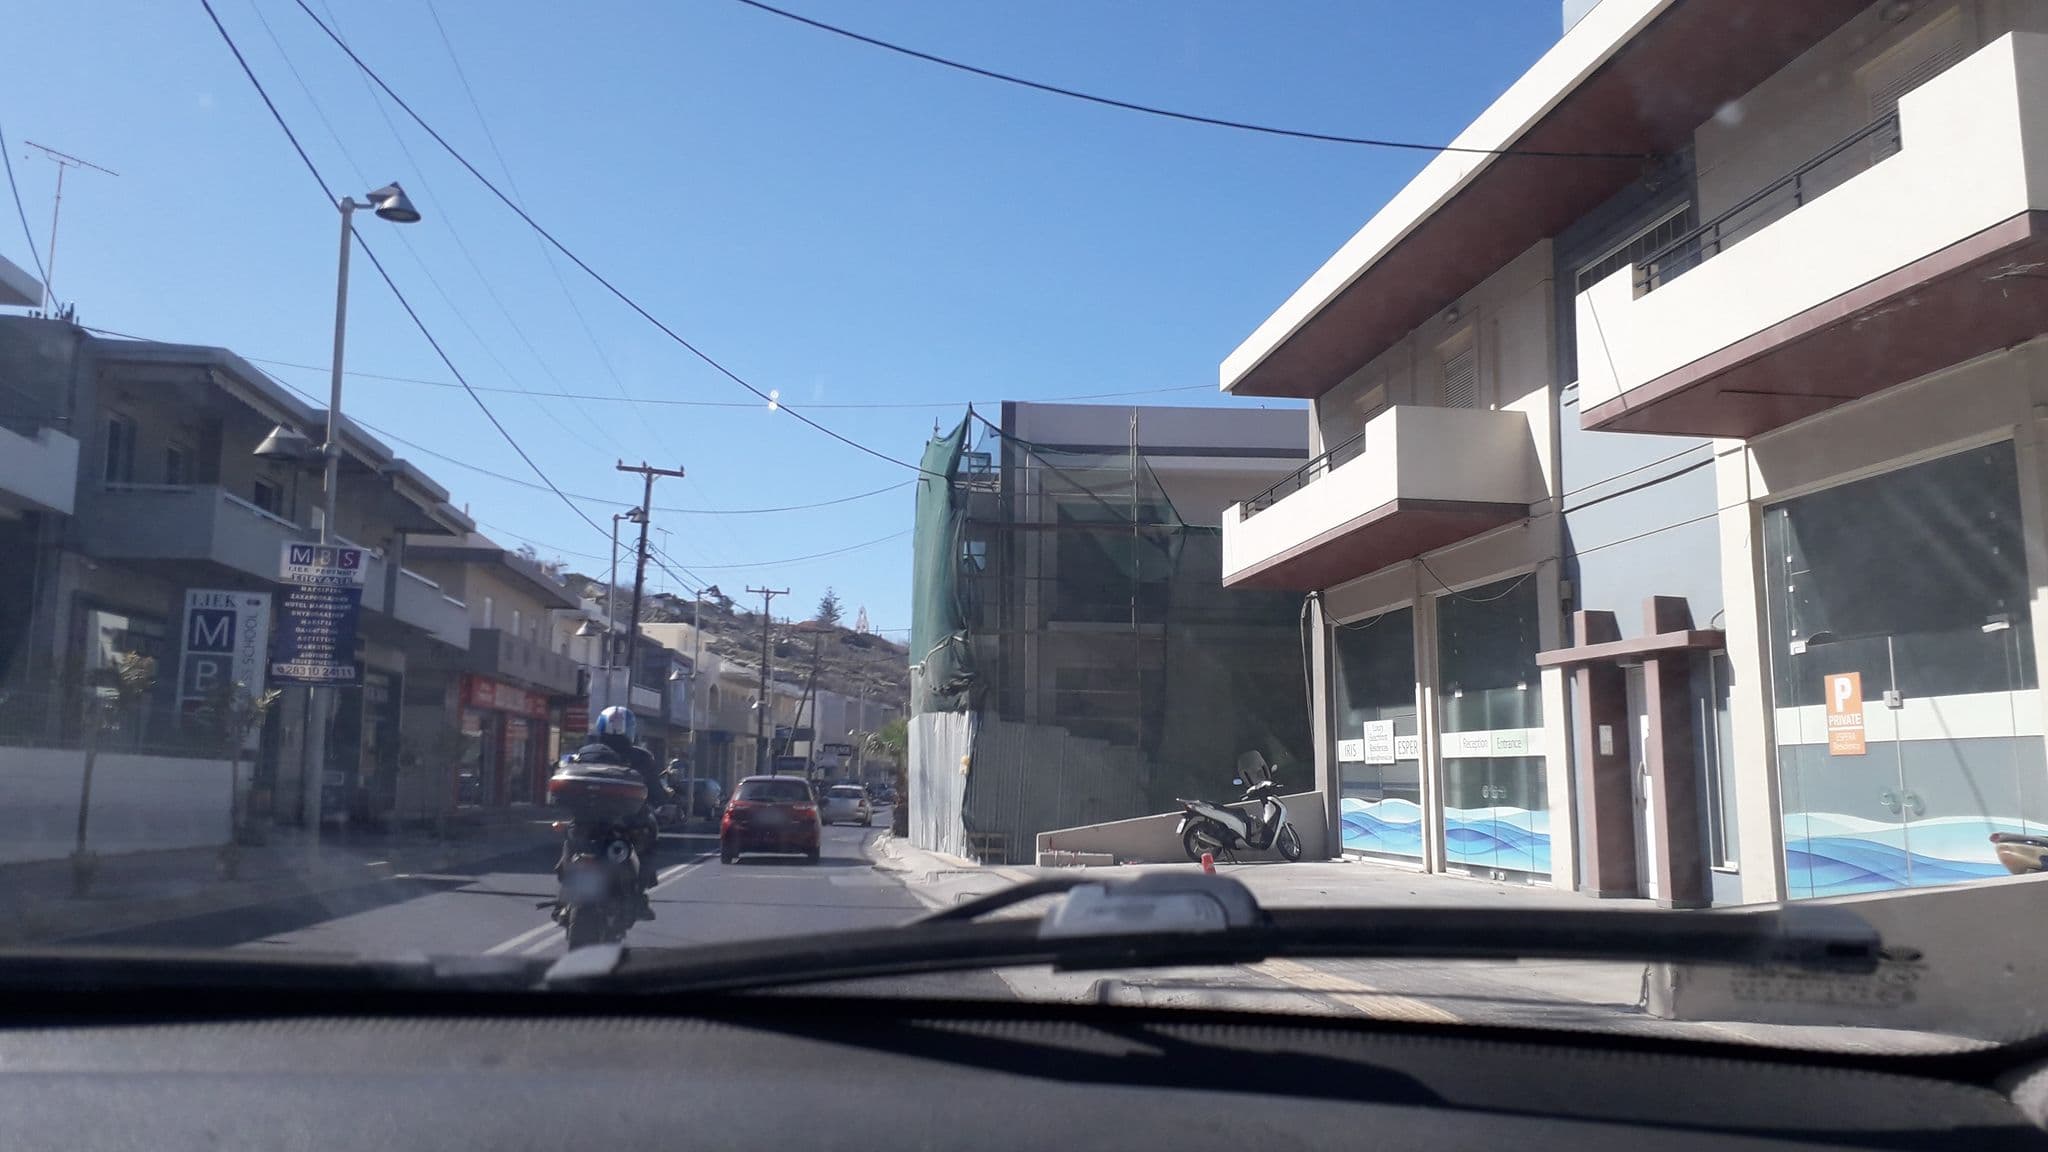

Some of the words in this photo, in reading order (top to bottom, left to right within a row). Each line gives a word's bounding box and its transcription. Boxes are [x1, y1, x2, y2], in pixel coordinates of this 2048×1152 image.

[194, 615, 228, 648] M
[241, 612, 258, 665] SCHOOL
[1833, 677, 1853, 713] P
[1828, 713, 1862, 727] PRIVATE
[1344, 743, 1358, 757] IRIS
[1462, 737, 1488, 750] Reception
[1496, 737, 1523, 750] Entrance
